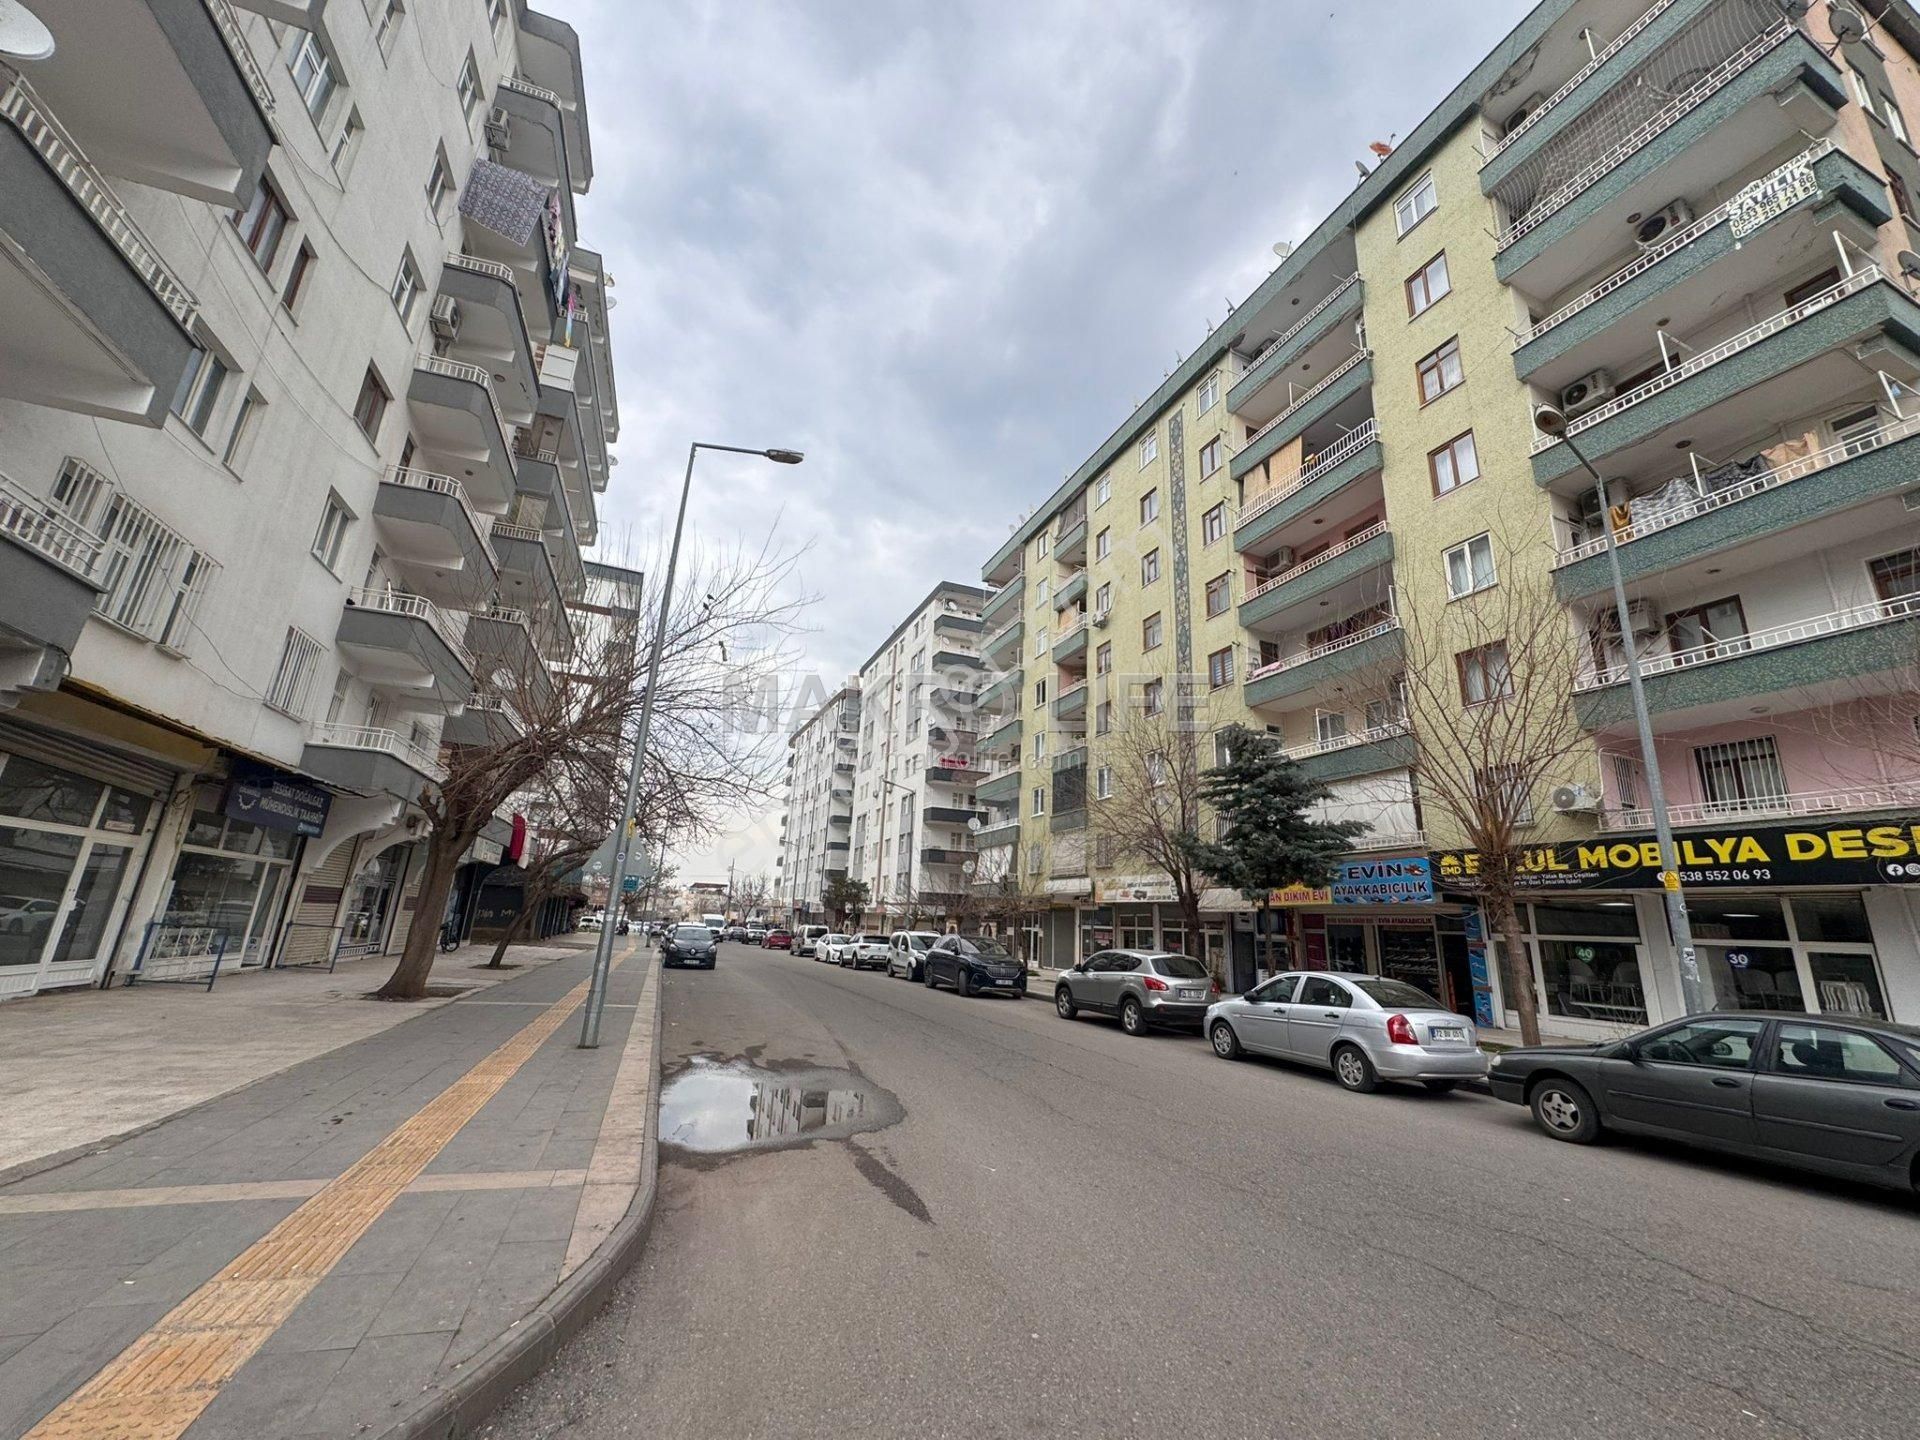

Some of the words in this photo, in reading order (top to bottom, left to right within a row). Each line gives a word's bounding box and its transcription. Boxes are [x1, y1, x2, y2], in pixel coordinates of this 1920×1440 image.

[1729, 161, 1812, 219] SATILIK
[1760, 193, 1780, 211] 965
[1782, 184, 1796, 197] 73
[1799, 174, 1814, 187] 86
[1763, 203, 1782, 220] 251
[1785, 193, 1799, 206] 21
[1803, 182, 1818, 196] 95
[1347, 861, 1403, 880] EVİN
[1441, 866, 1461, 875] EMD
[1705, 870, 1731, 881] 552
[1732, 869, 1750, 880] 06
[1753, 869, 1771, 880] 93
[1334, 881, 1428, 896] AYAKKABICILIK
[1729, 953, 1748, 965] 30
